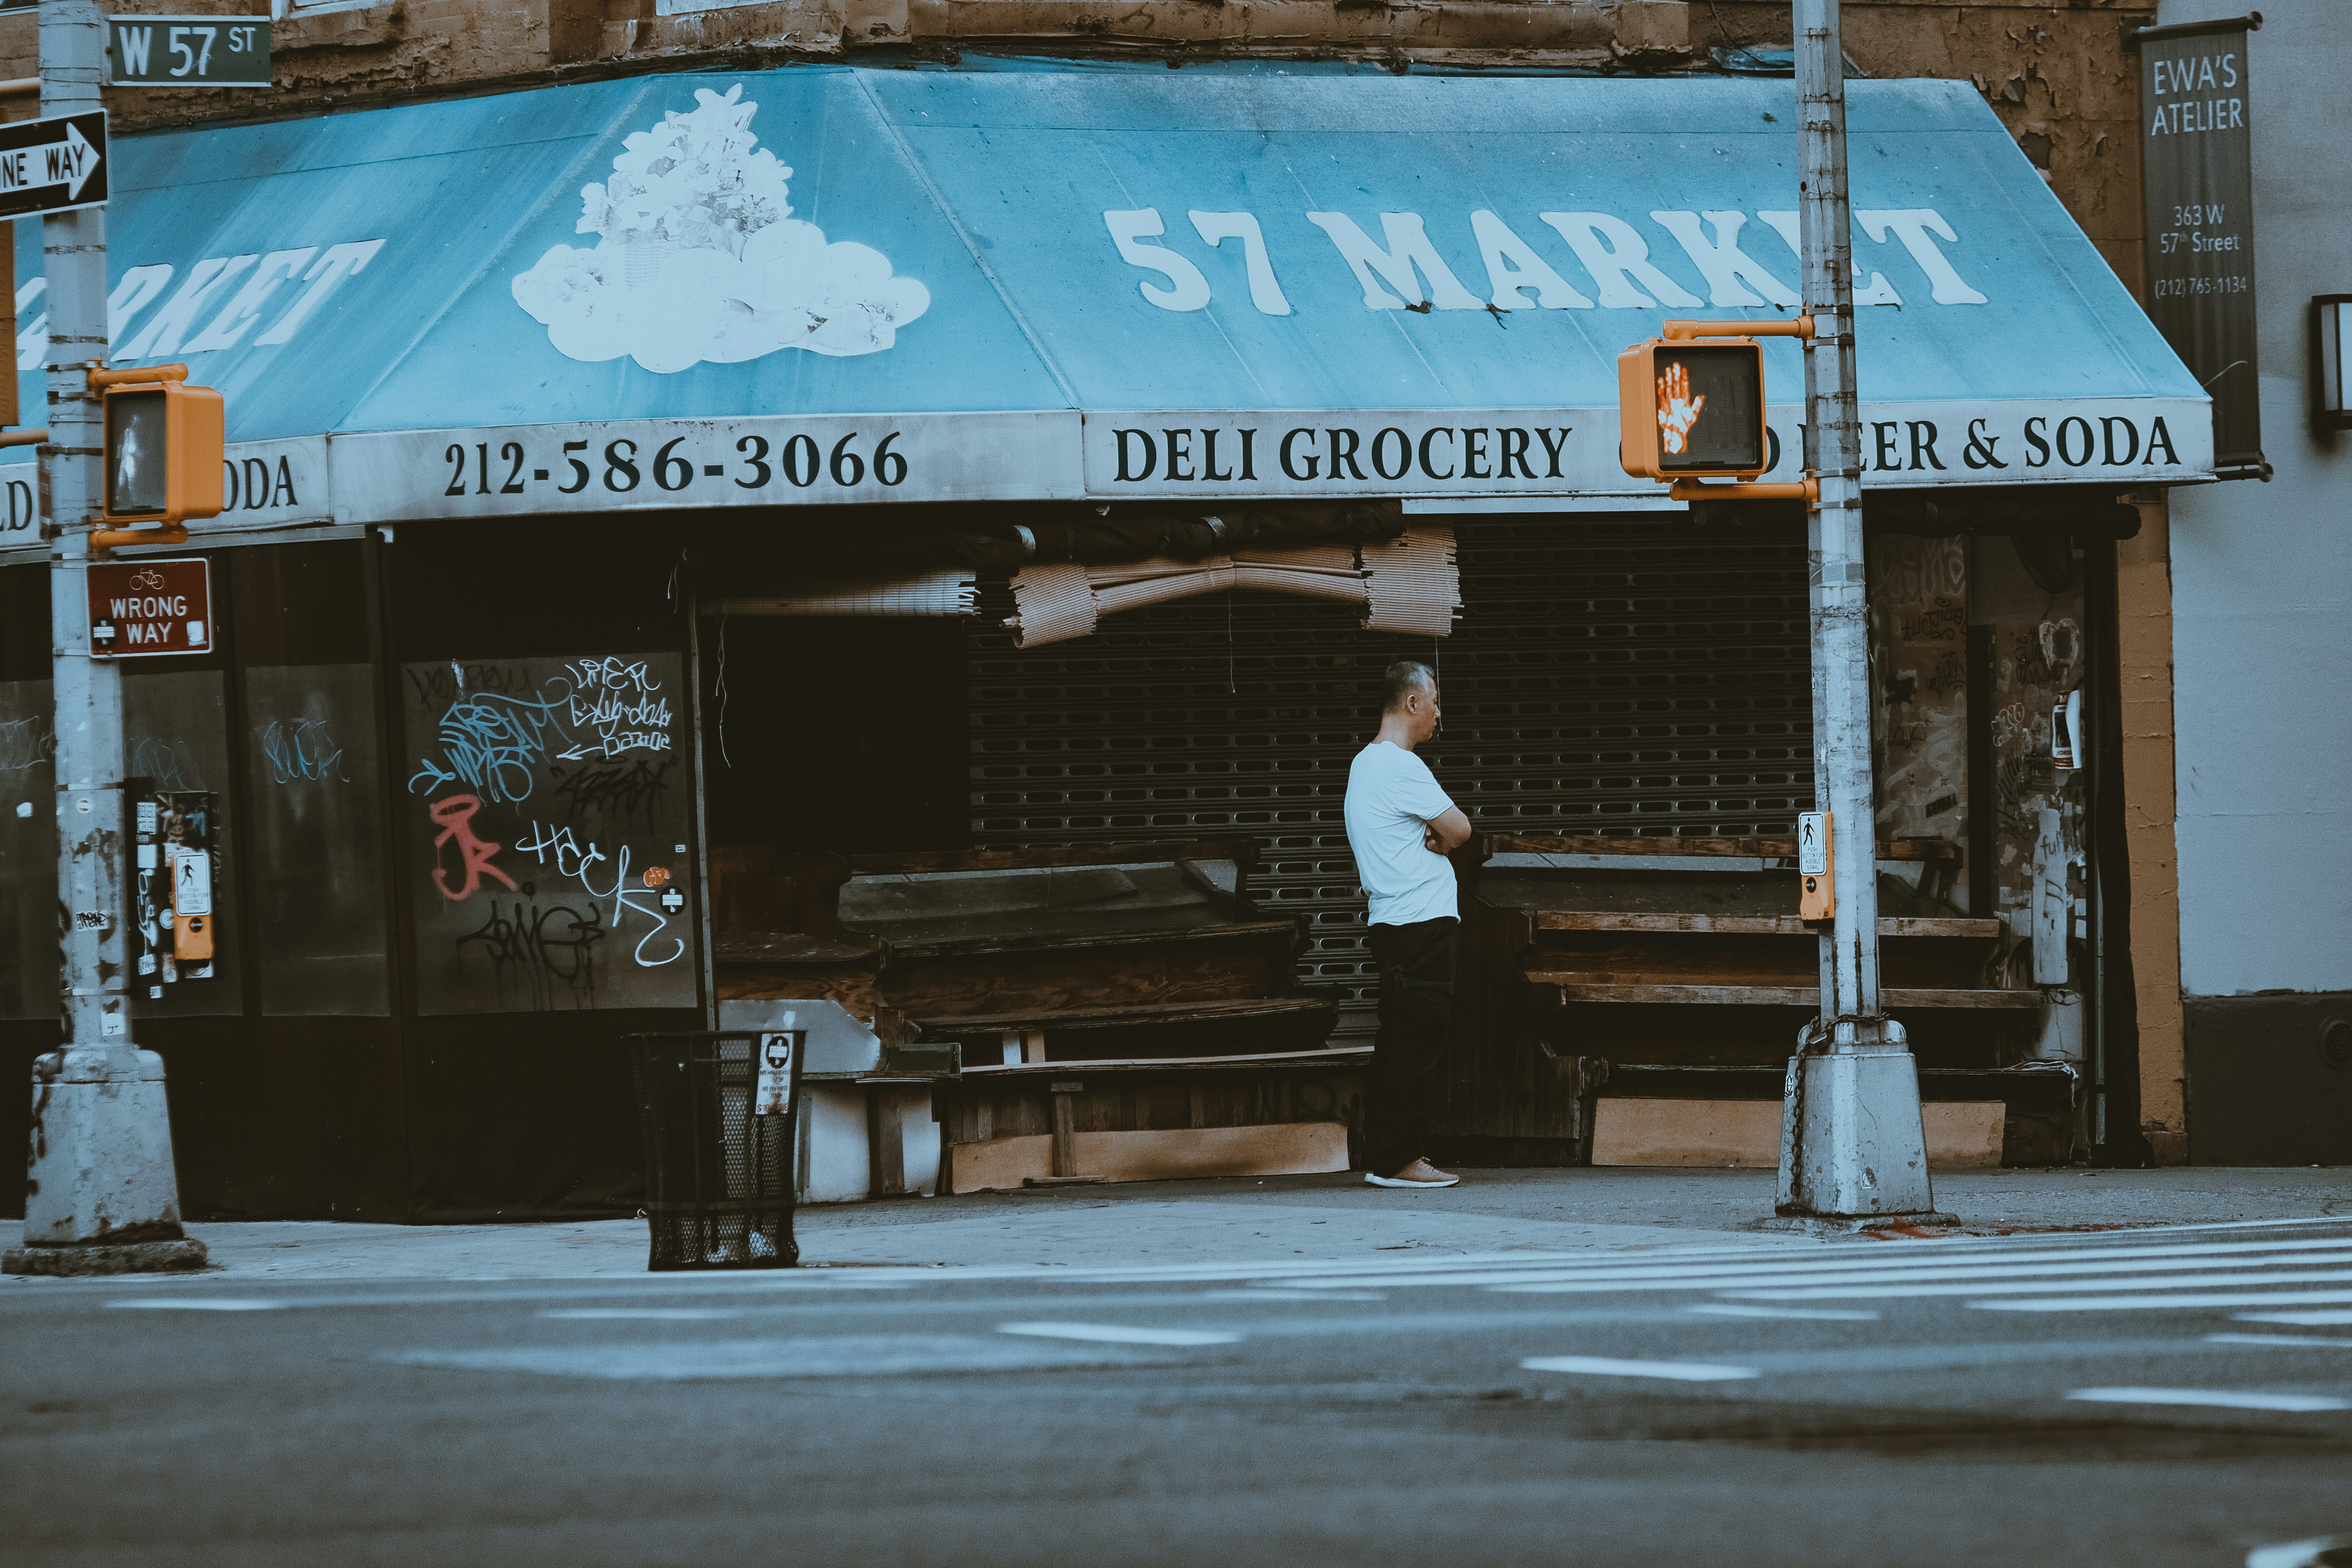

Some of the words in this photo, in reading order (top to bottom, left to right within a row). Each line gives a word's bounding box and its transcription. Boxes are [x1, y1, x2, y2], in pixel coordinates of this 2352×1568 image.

[118, 26, 152, 75] W
[169, 26, 217, 76] 57
[229, 26, 257, 52] ST
[2154, 53, 2237, 94] EWA'S
[2151, 98, 2243, 136] ATELIER
[2, 152, 28, 188] NE
[45, 143, 85, 181] WAY
[2174, 205, 2202, 226] 363
[2205, 204, 2225, 225] W
[2192, 231, 2241, 252] Street
[1103, 207, 1291, 316] 57
[2154, 278, 2186, 299] (212)
[2189, 276, 2247, 294] 765-1134
[444, 431, 908, 497] 212-586-3066
[1112, 427, 1258, 482] DELI
[1279, 426, 1572, 481] GROCERY
[1963, 417, 2009, 470] &
[2024, 416, 2181, 468] SODA
[110, 595, 187, 619] WRONG
[126, 622, 172, 644] WAY
